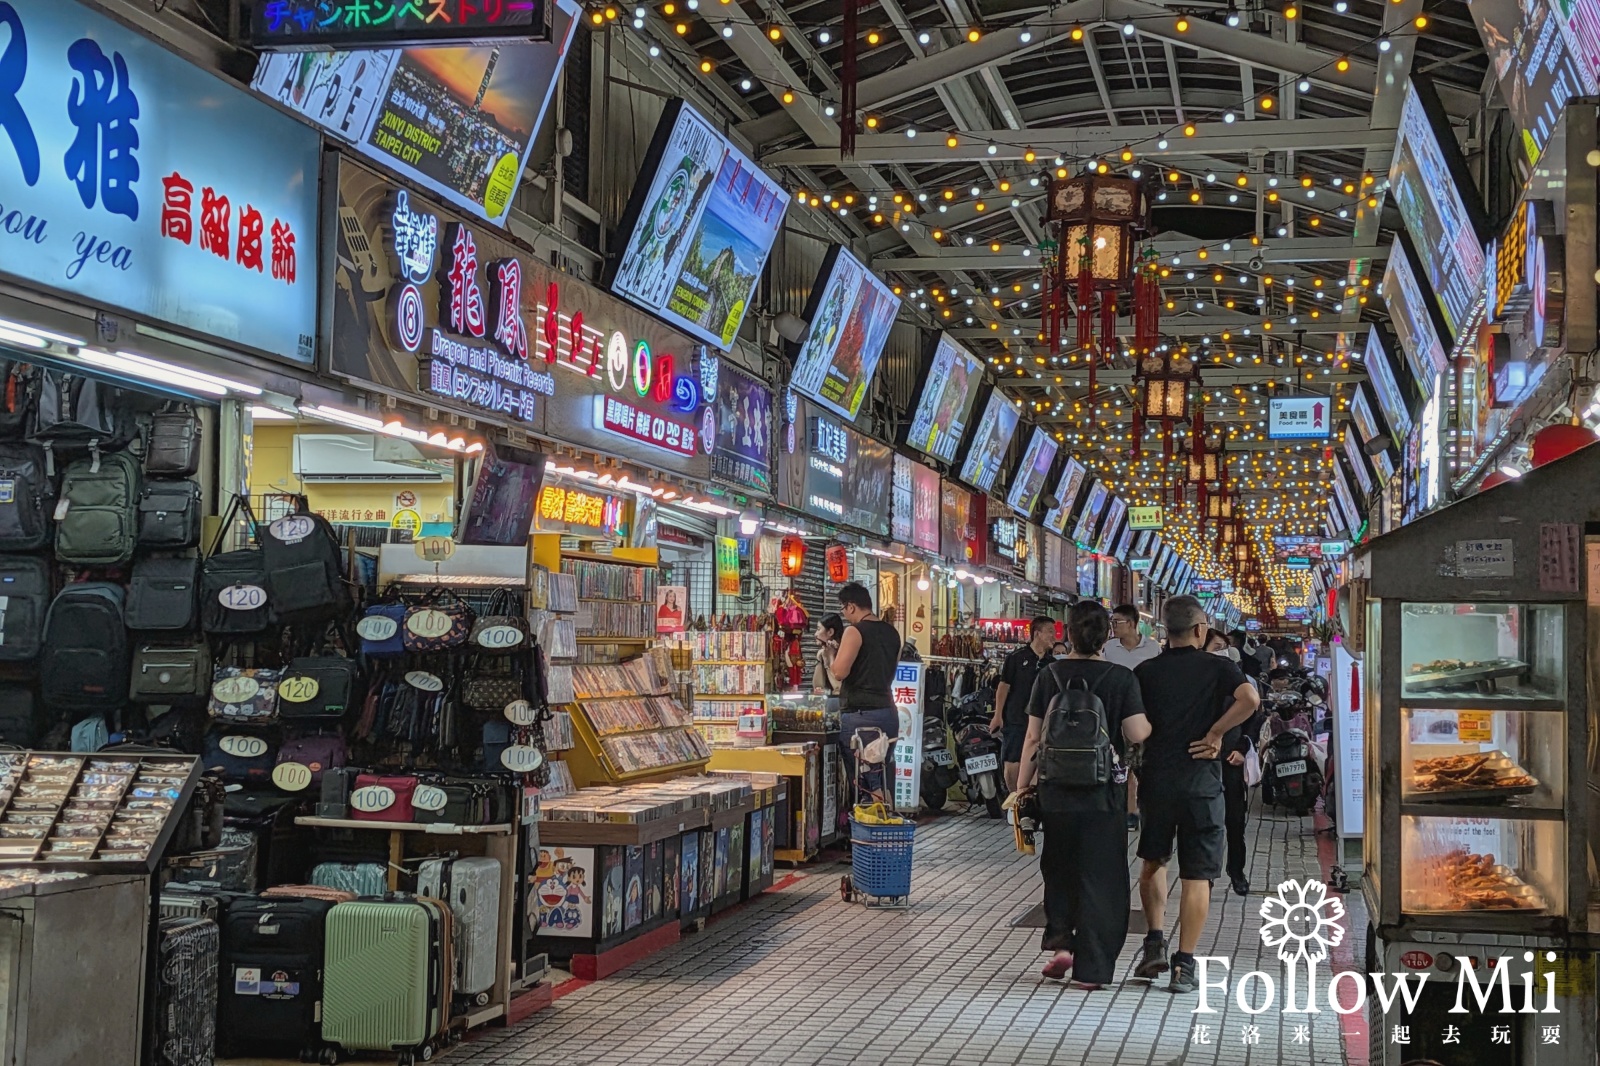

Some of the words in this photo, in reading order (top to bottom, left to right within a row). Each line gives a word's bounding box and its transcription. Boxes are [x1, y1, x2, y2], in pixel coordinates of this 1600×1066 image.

[381, 110, 406, 135] XINYI
[404, 123, 441, 154] DISTRICT
[376, 130, 404, 155] TAIPEI
[402, 143, 422, 165] CITY
[0, 204, 48, 244] ou
[66, 230, 133, 280] yea
[448, 222, 528, 360] 龍鳳
[432, 329, 469, 366] Dragon
[469, 348, 487, 372] and
[488, 350, 522, 386] Phoenix
[523, 363, 555, 396] Records
[1279, 411, 1308, 420] 美食區
[652, 418, 665, 441] CD
[666, 421, 680, 441] DVD
[276, 519, 309, 538] 120
[422, 540, 451, 555] 100
[225, 589, 261, 606] 120
[415, 615, 446, 631] 100
[485, 629, 518, 645] 100
[284, 681, 314, 699] 120
[411, 674, 438, 690] 100
[226, 738, 262, 755] 100
[507, 750, 537, 765] 100
[278, 767, 307, 785] 100
[356, 790, 389, 808] 100
